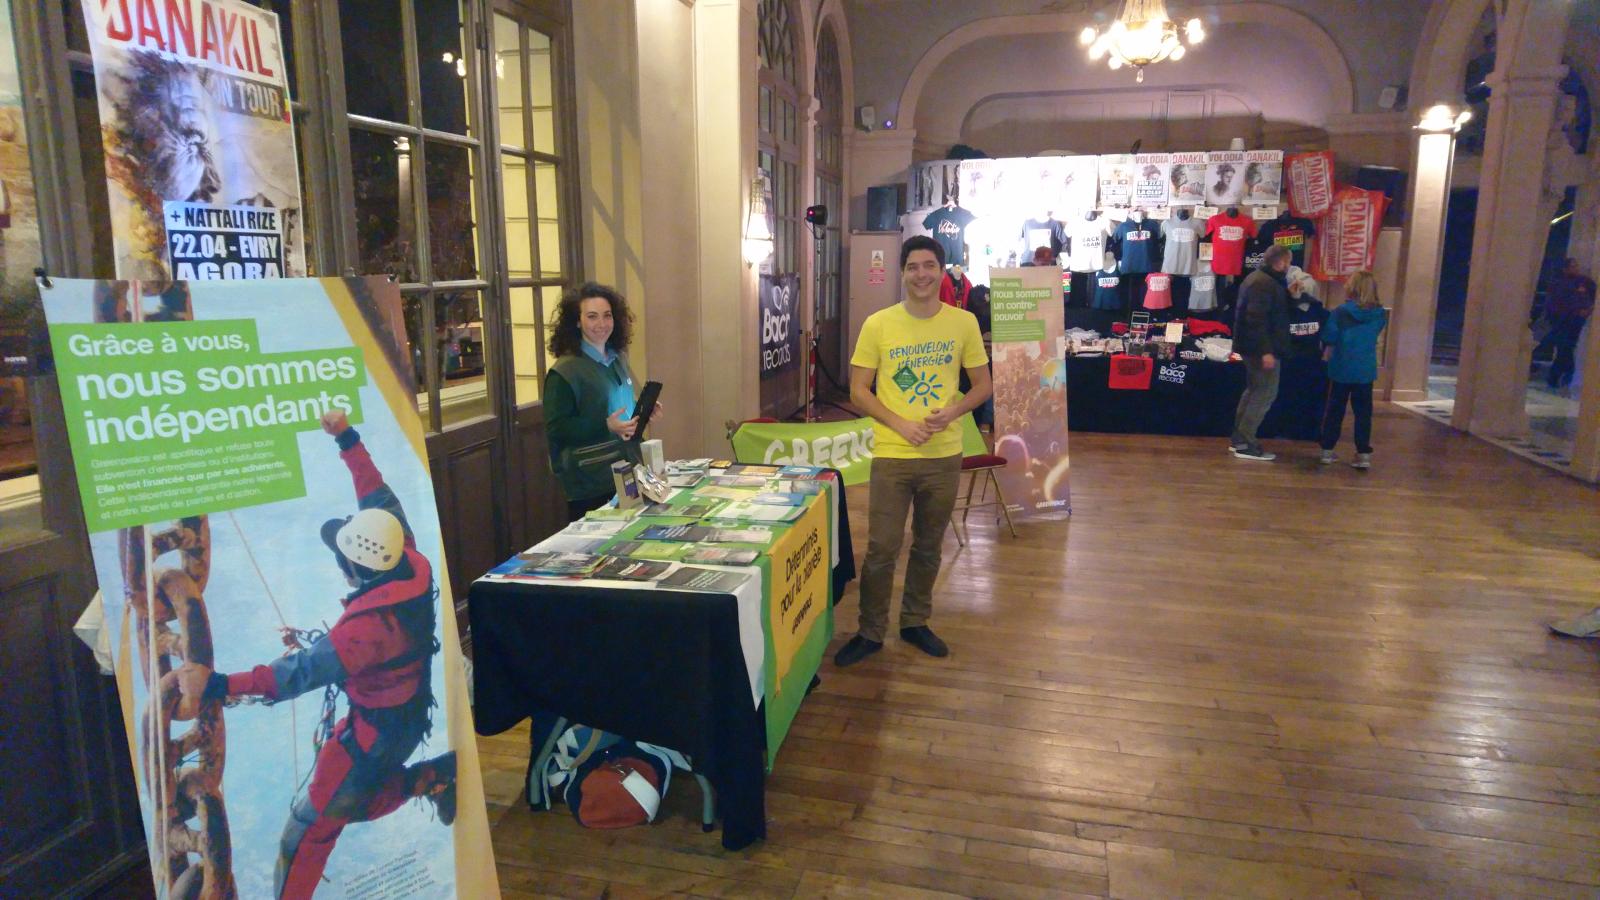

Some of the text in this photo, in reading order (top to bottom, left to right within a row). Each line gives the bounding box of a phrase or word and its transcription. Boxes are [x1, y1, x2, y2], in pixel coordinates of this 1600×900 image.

[235, 80, 281, 117] TOUR
[1135, 155, 1168, 164] VOLODIA
[1172, 154, 1205, 164] DANAKIL
[1209, 153, 1243, 161] VOLODIA
[1246, 151, 1280, 161] DANAKIL
[1304, 158, 1327, 207] DANAKIL
[184, 207, 245, 229] NATTALI
[247, 211, 276, 230] RIZE
[172, 233, 227, 258] 22.04
[239, 235, 278, 258] EVRY
[1342, 202, 1366, 272] DANAKIL
[176, 261, 281, 280] AGORA
[993, 290, 1051, 299] nous sommes
[993, 302, 1005, 310] un
[68, 331, 250, 357] Grâce à vous,
[889, 340, 956, 360] RENOUVELONS
[76, 355, 357, 400] nous sommes
[1159, 375, 1184, 384] records
[1160, 365, 1185, 378] Baco
[83, 390, 353, 446] indépendants
